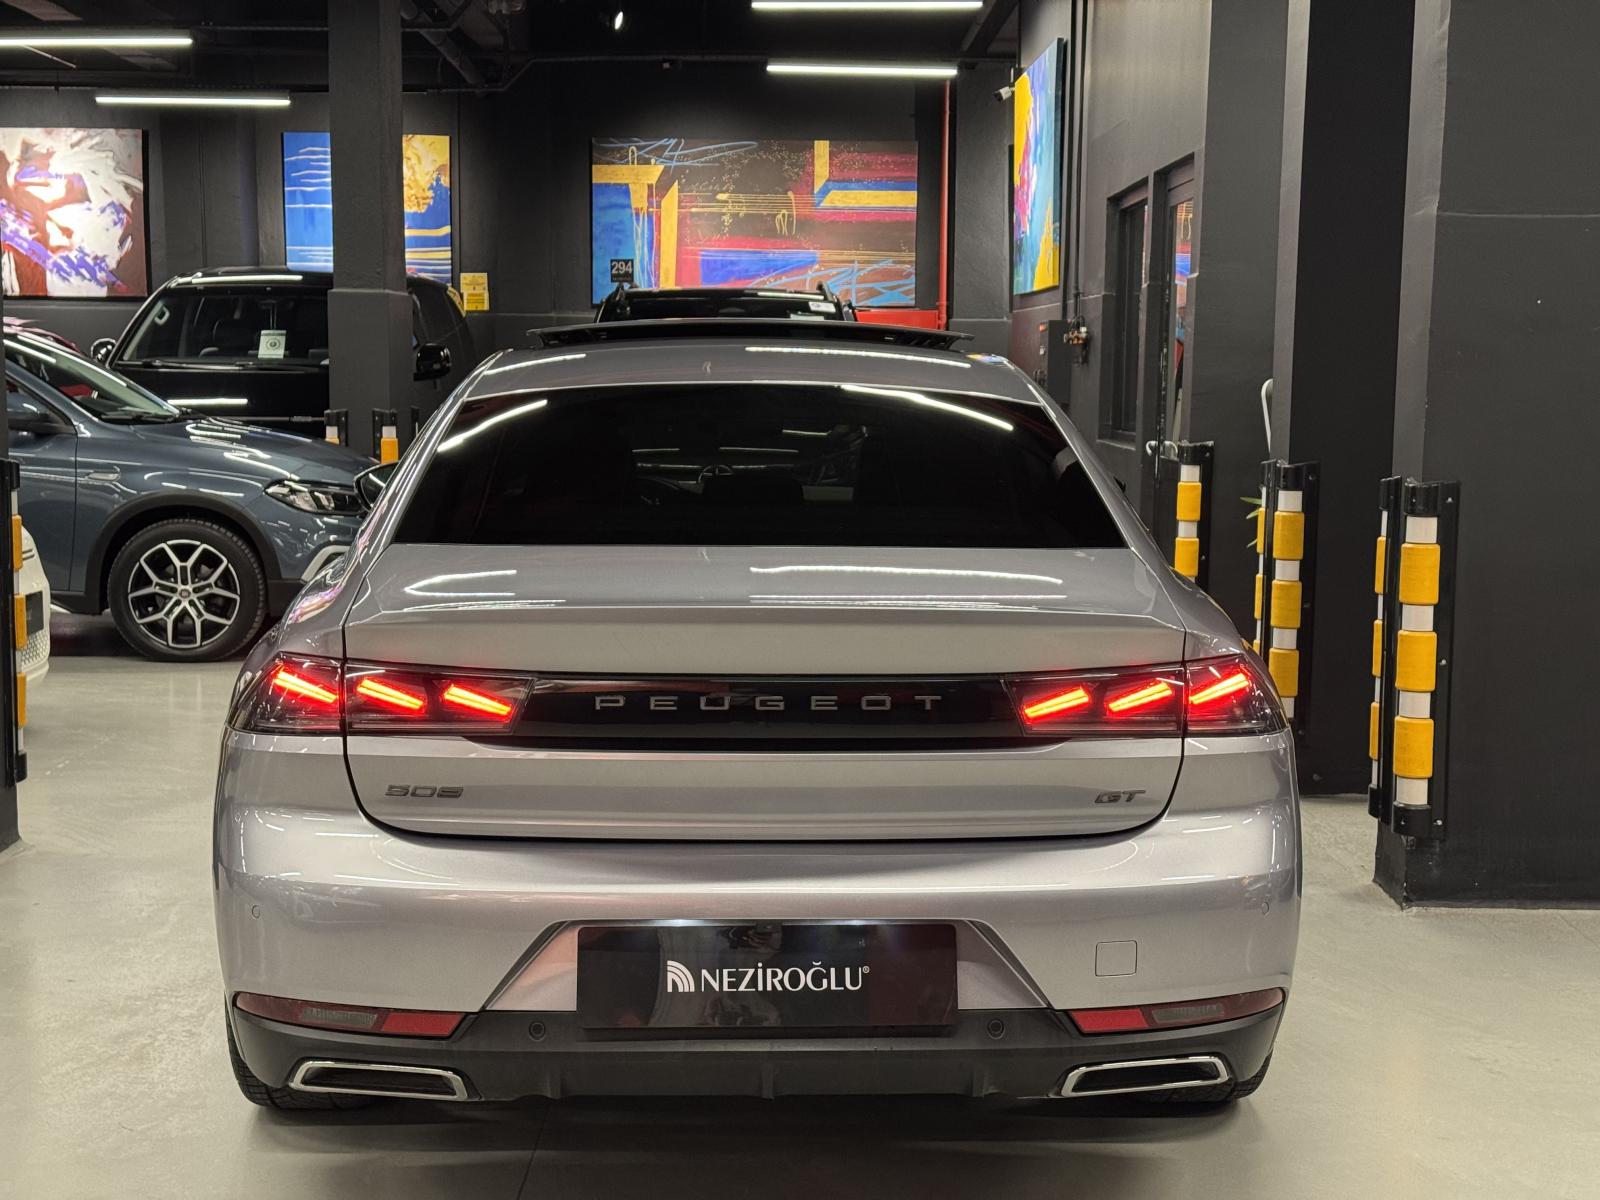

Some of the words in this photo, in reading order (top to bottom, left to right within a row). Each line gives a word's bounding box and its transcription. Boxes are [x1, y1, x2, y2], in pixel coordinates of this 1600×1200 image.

[611, 260, 633, 274] 294
[595, 695, 942, 711] PEUGEOT
[384, 784, 464, 799] 508
[1094, 789, 1146, 804] GT
